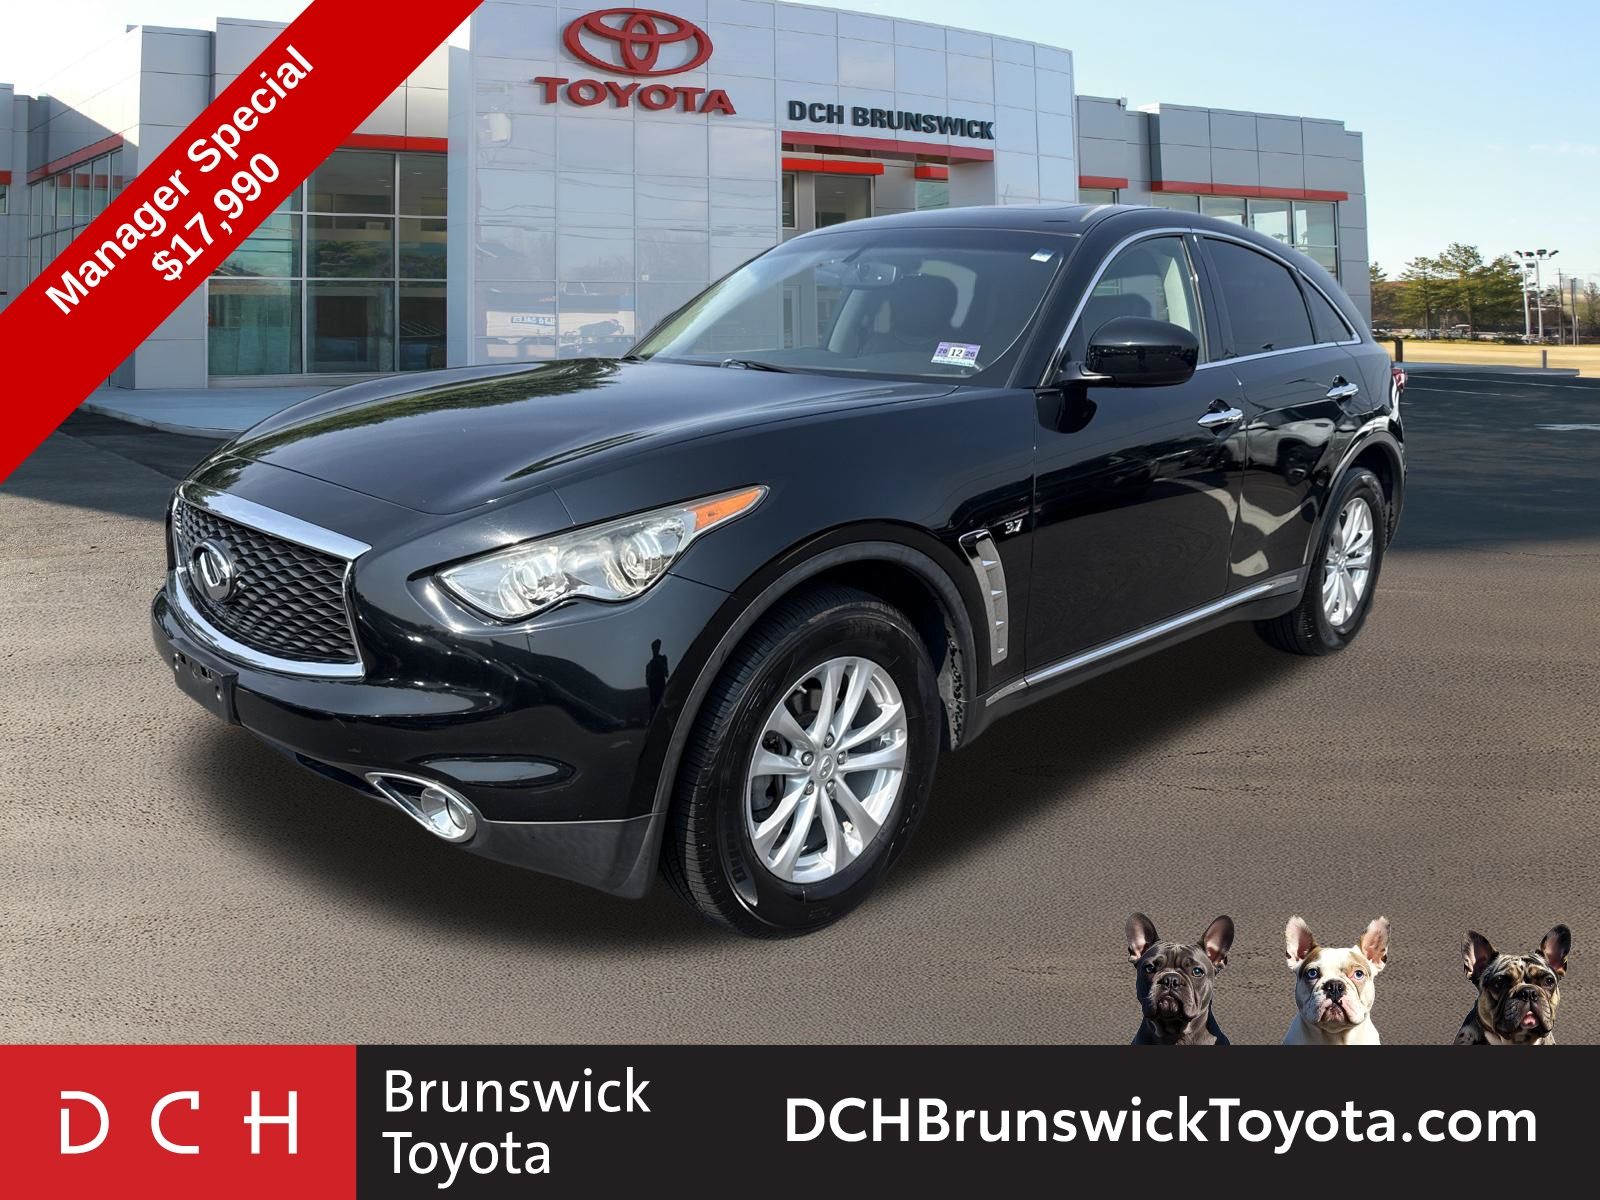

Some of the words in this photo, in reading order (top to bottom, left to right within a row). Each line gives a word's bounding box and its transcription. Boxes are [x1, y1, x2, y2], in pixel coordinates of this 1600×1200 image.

[534, 76, 737, 115] TOYOTA
[788, 100, 845, 124] DCH
[852, 106, 995, 140] BRUNSWICK
[951, 348, 963, 357] 12
